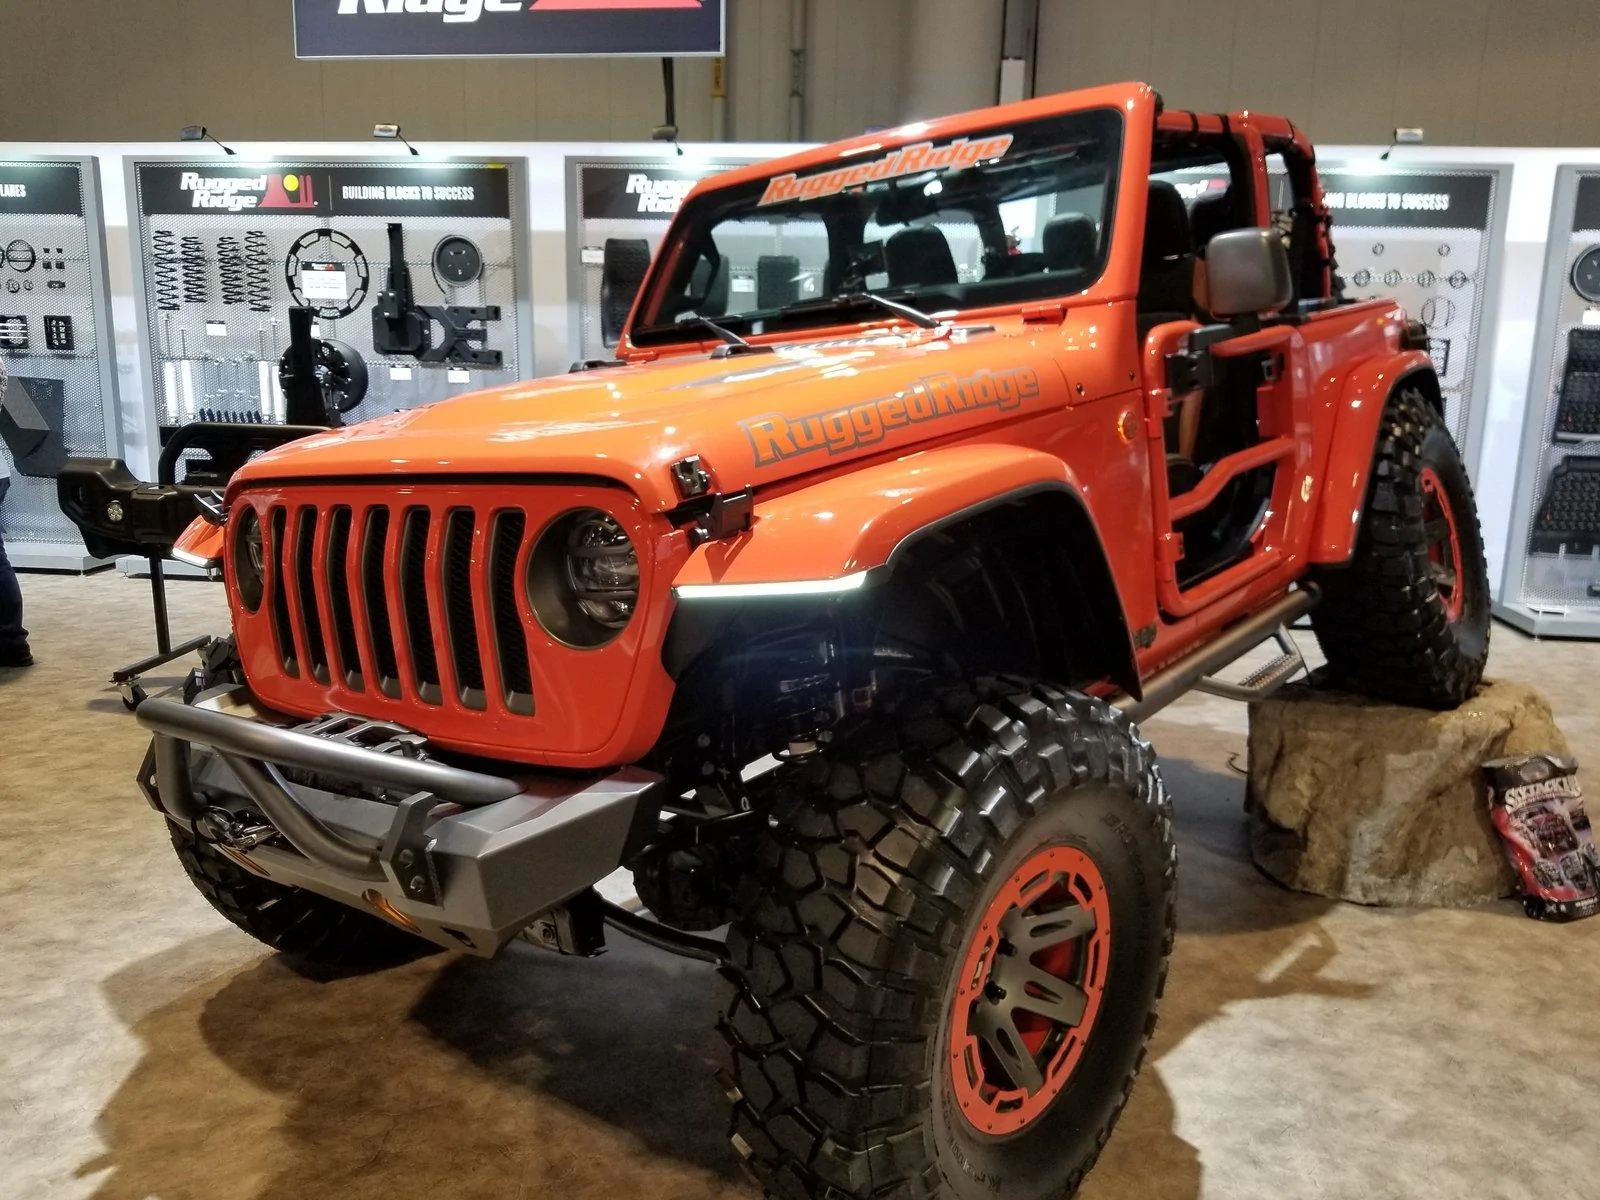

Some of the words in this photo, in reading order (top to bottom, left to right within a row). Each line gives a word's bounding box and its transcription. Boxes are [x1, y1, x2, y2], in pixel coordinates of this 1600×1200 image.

[0, 183, 27, 198] LARES
[180, 172, 268, 194] Rugged
[342, 185, 386, 200] BUILDING
[433, 186, 475, 200] SUCCESS
[192, 190, 258, 211] Ridge
[1401, 193, 1450, 210] SUCCESS
[738, 367, 1040, 468] RuggedRidge
